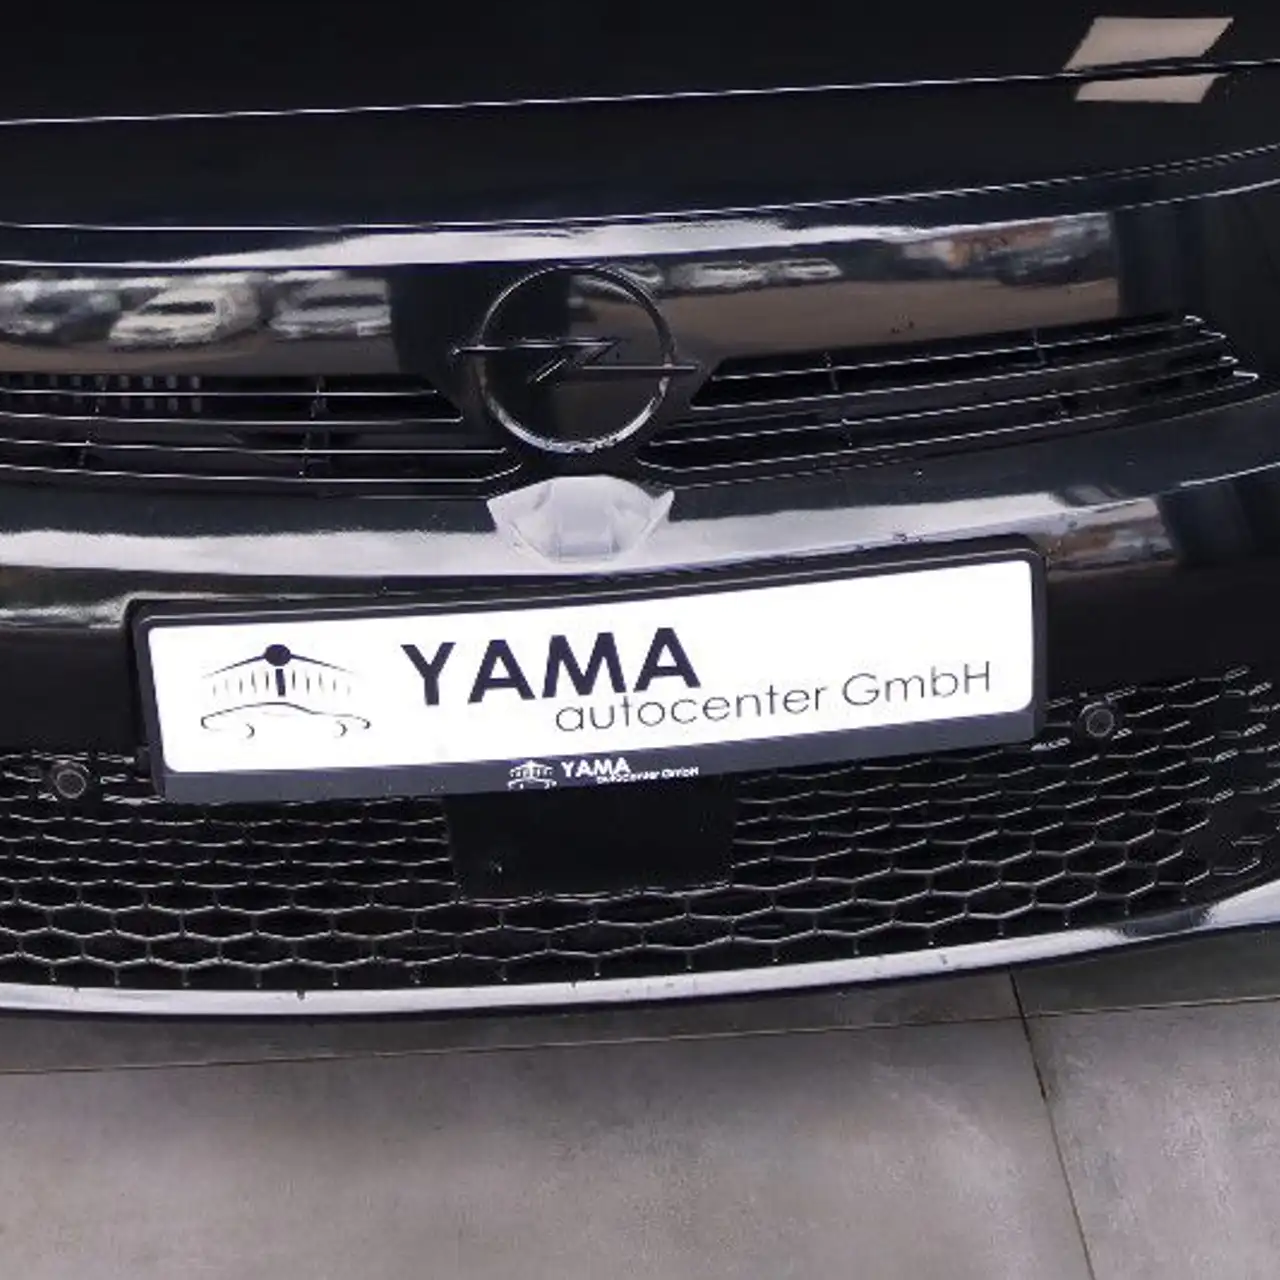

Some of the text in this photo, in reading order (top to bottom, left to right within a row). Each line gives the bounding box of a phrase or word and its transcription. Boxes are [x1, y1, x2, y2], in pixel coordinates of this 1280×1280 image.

[400, 627, 701, 706] YAMA
[556, 661, 990, 732] autocenter GmbH
[561, 757, 631, 778] YAMA
